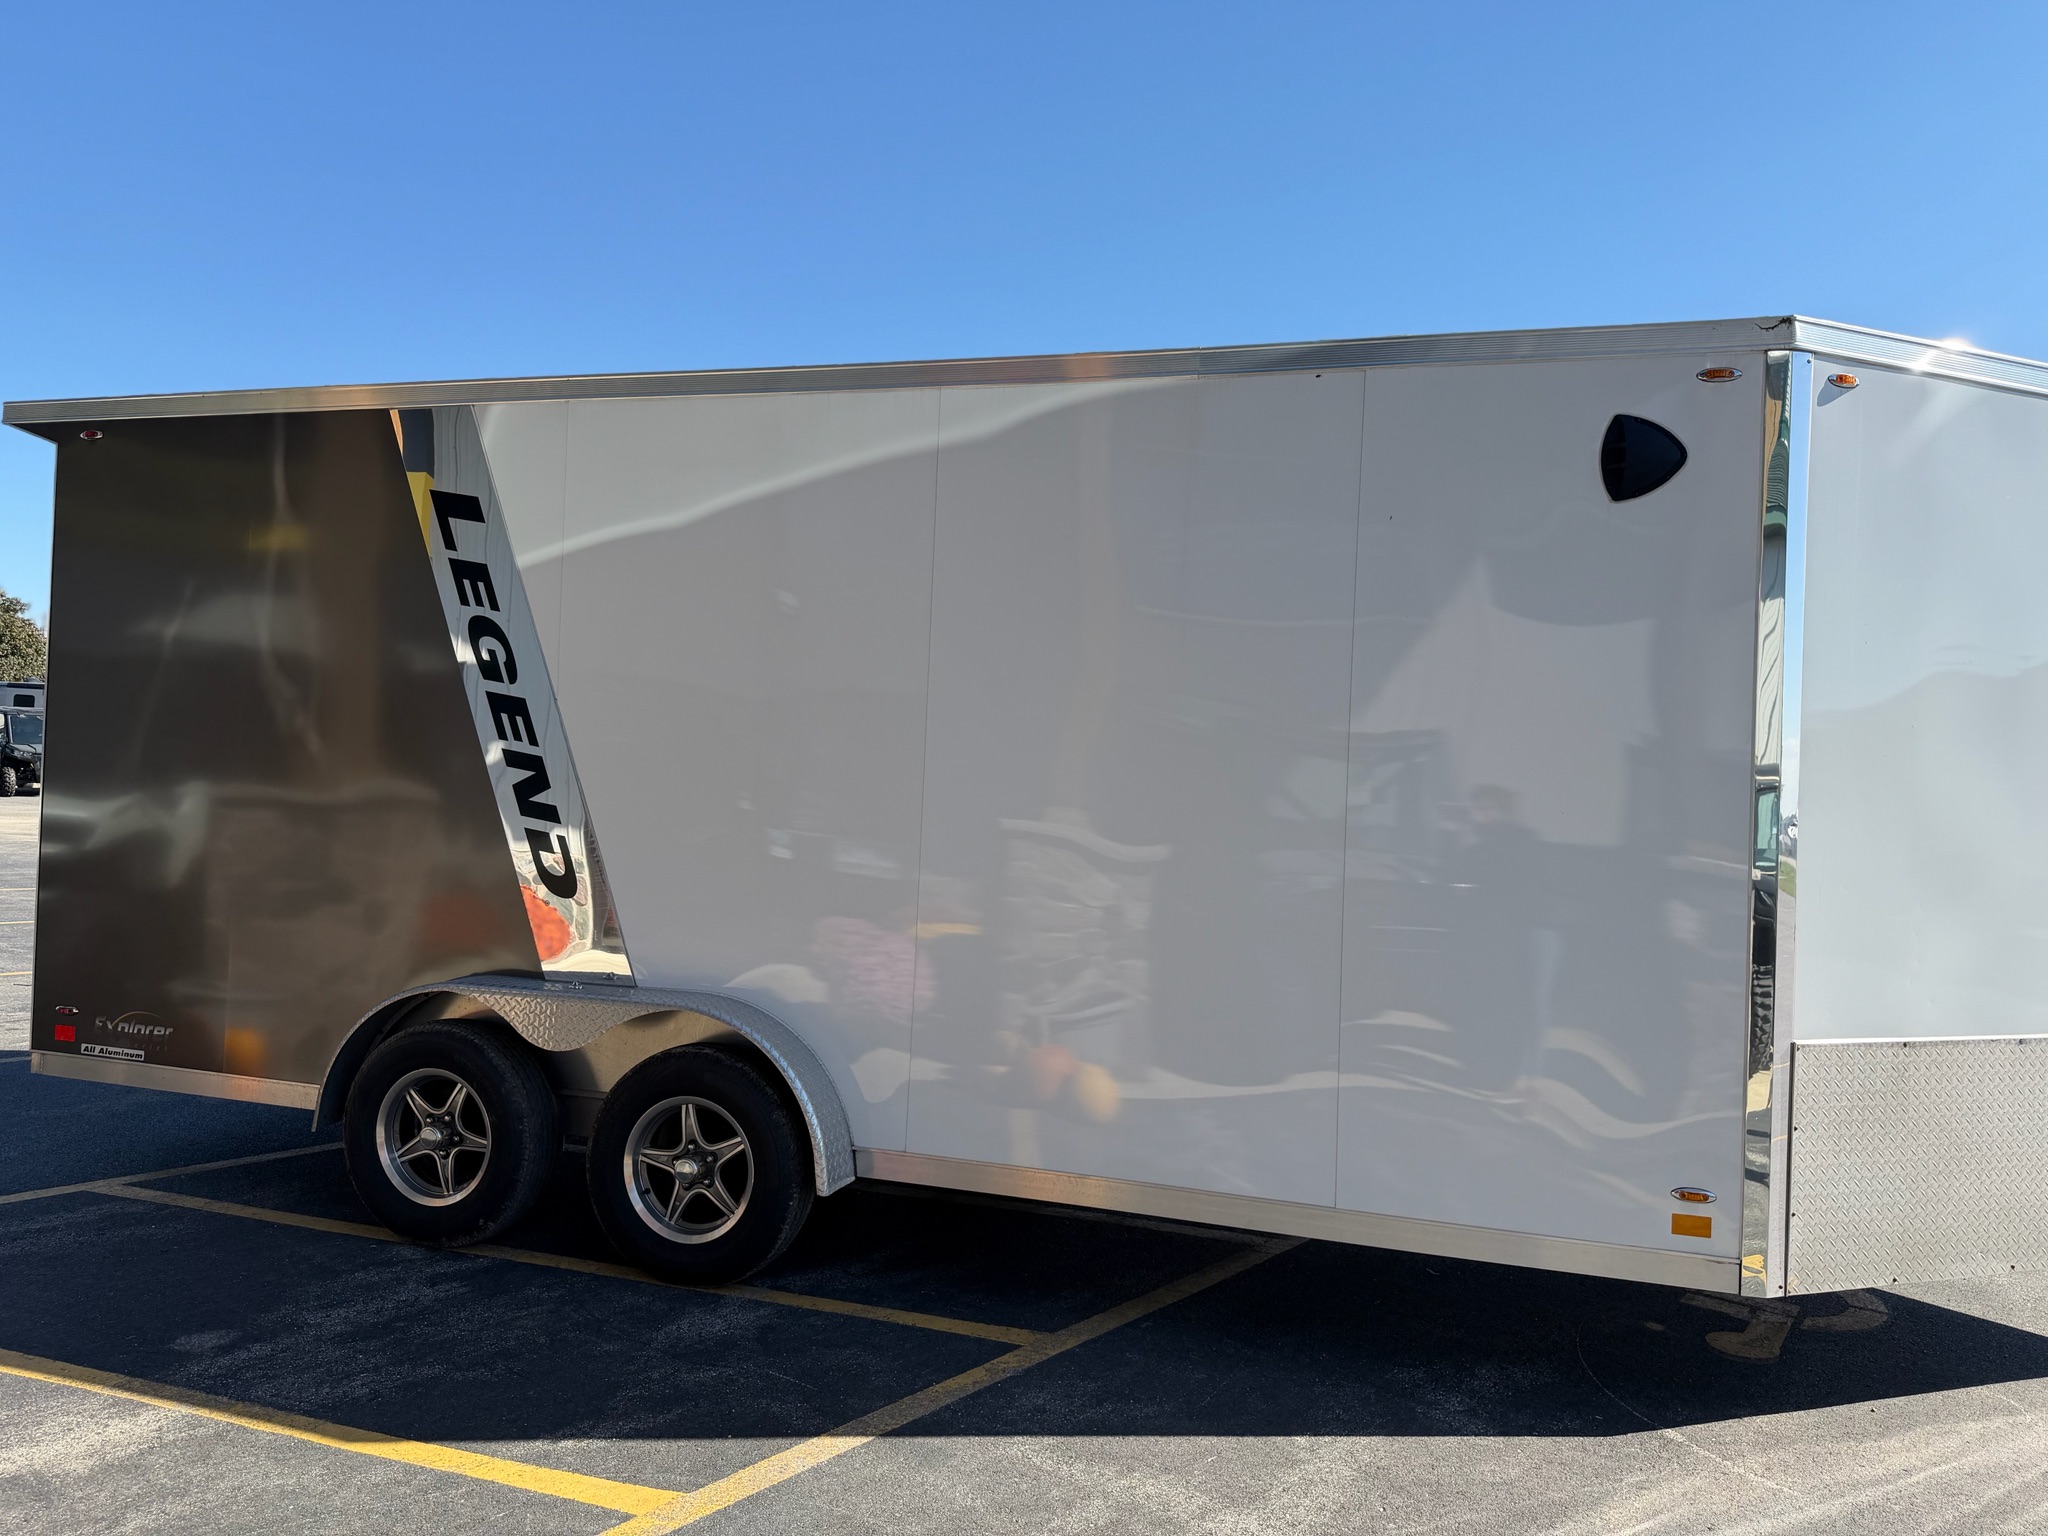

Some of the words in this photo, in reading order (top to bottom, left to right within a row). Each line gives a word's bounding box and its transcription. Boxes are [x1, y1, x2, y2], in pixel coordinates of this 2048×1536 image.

[430, 489, 578, 900] LEGEND
[83, 1045, 96, 1054] All
[98, 1047, 143, 1059] Aluminum
